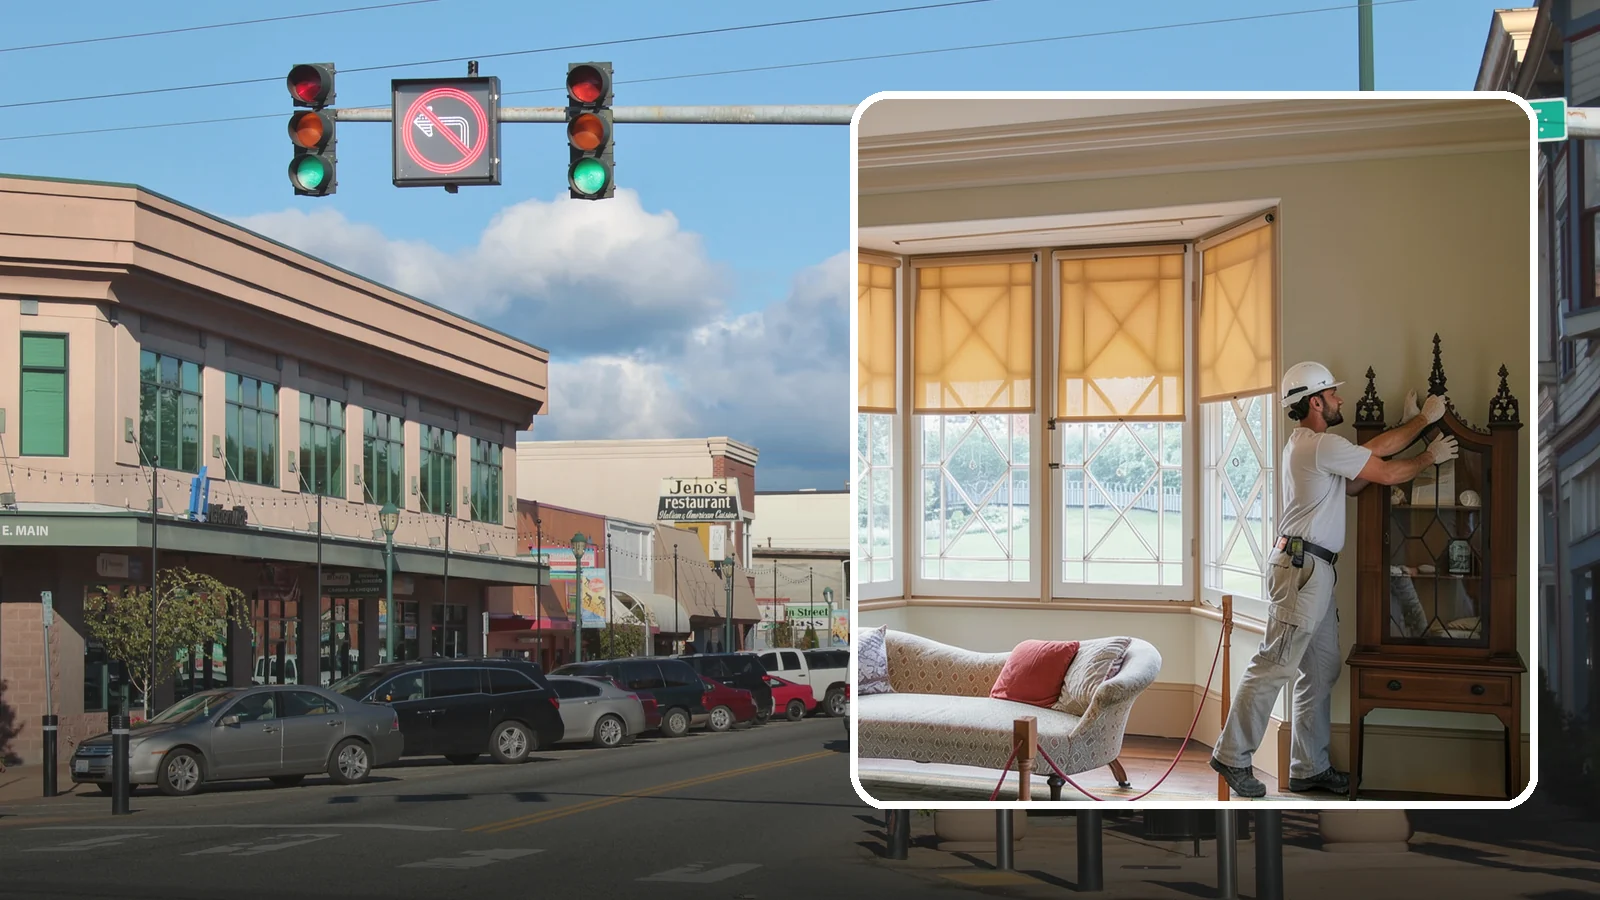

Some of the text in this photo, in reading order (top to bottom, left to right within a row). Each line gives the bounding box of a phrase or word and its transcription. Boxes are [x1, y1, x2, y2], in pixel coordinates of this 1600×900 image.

[670, 480, 727, 494] Jeno's
[665, 497, 731, 509] restaurant
[659, 510, 681, 519] Italian
[686, 510, 714, 519] American
[715, 510, 737, 519] Cuisine
[2, 525, 49, 536] E. MAIN
[797, 608, 828, 617] Street
[791, 619, 824, 627] lass
